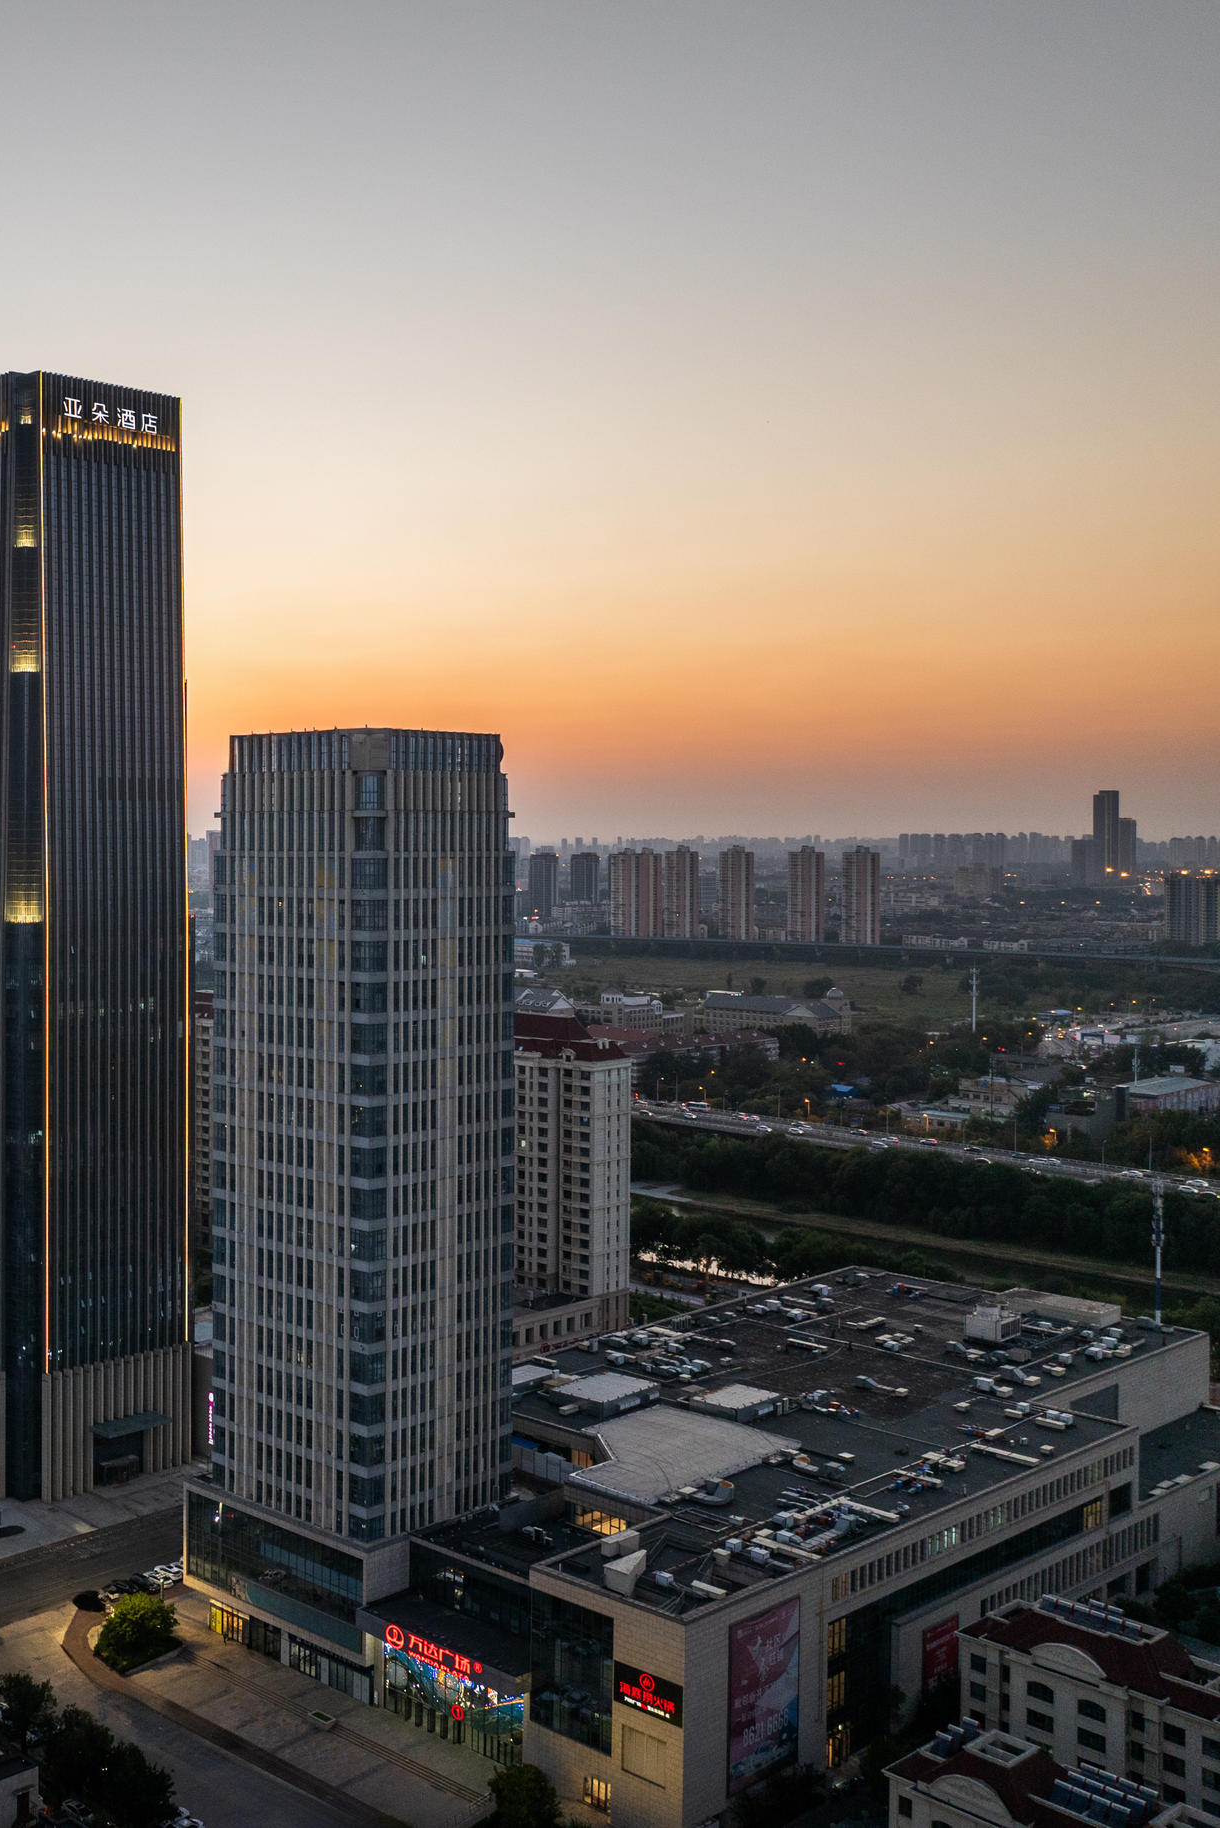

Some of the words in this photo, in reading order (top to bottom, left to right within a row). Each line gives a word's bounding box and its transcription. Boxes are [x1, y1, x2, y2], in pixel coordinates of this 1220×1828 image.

[63, 396, 158, 434] 亚朵酒店
[408, 1633, 471, 1675] 万达广场
[408, 1649, 440, 1668] WANDA
